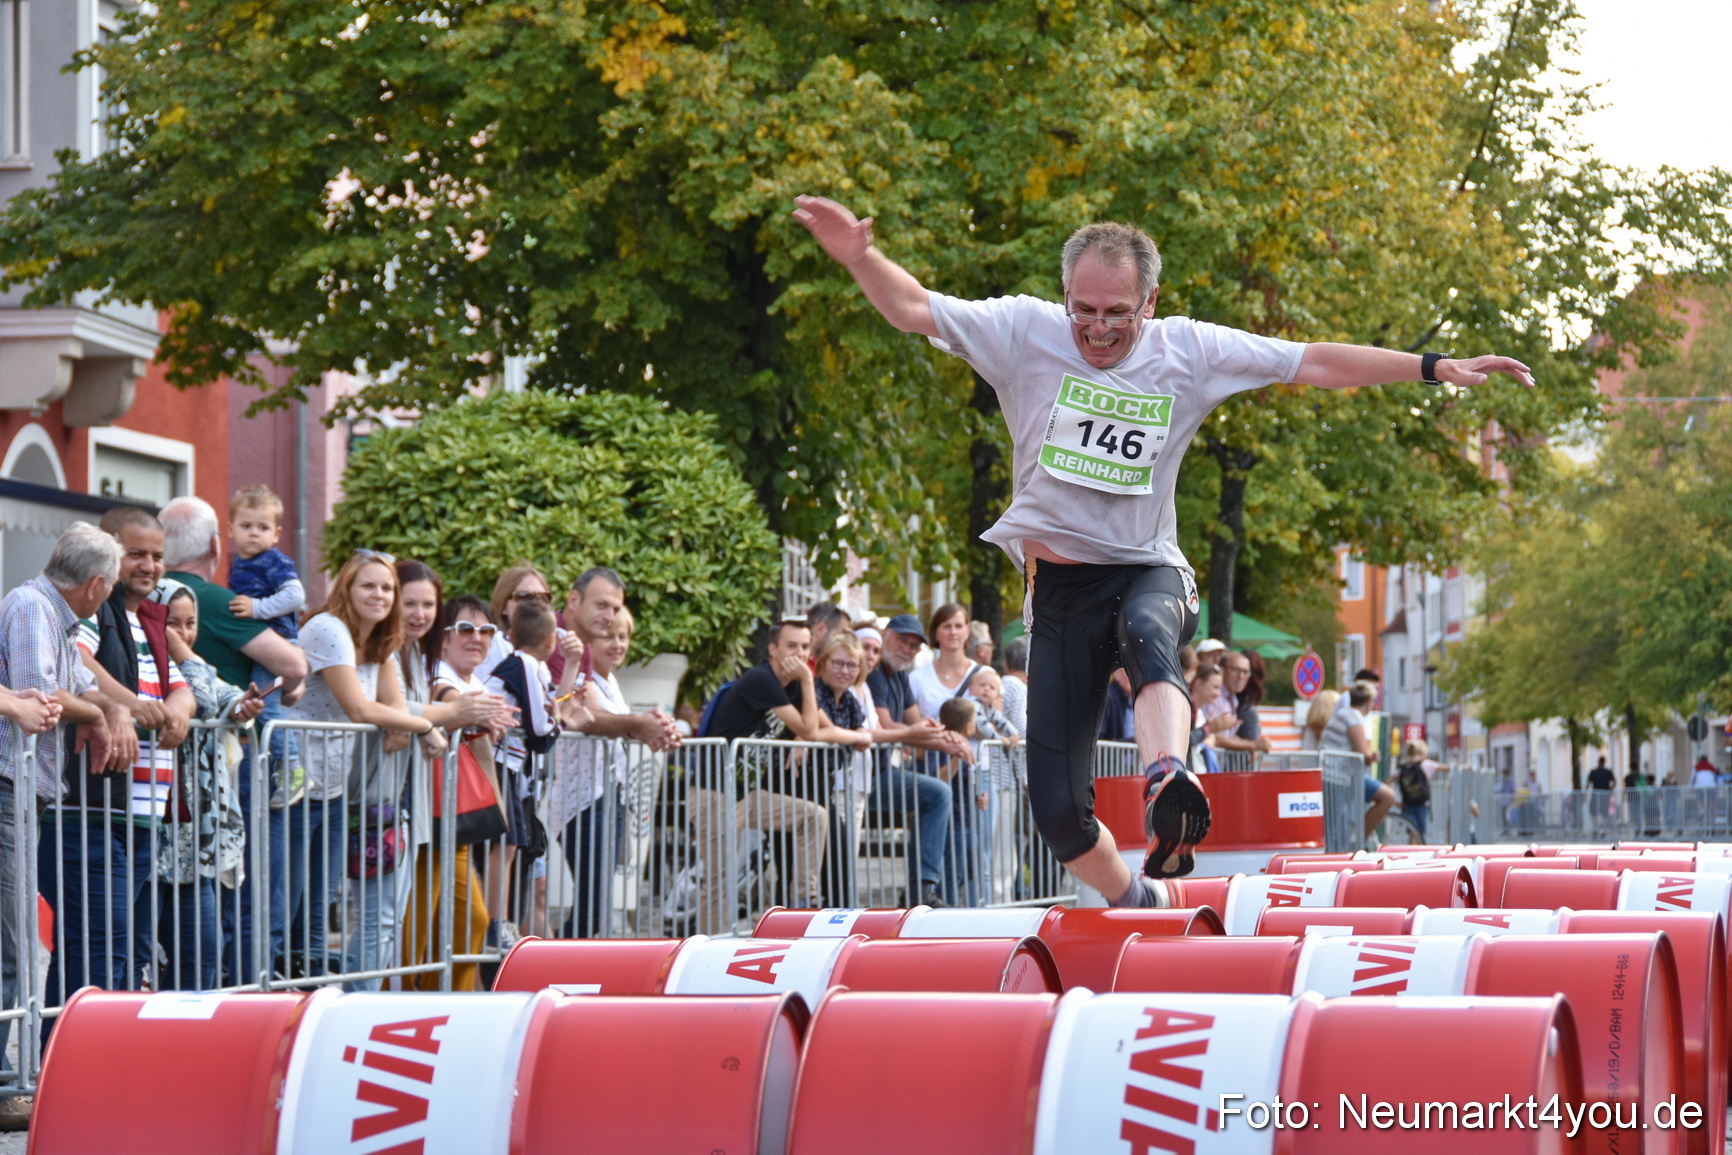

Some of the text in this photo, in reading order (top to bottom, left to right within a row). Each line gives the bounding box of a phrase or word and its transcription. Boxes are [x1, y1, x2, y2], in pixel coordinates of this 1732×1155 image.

[1067, 382, 1163, 422] BOCK
[1078, 420, 1146, 460] 146
[1053, 452, 1143, 483] REINHARD
